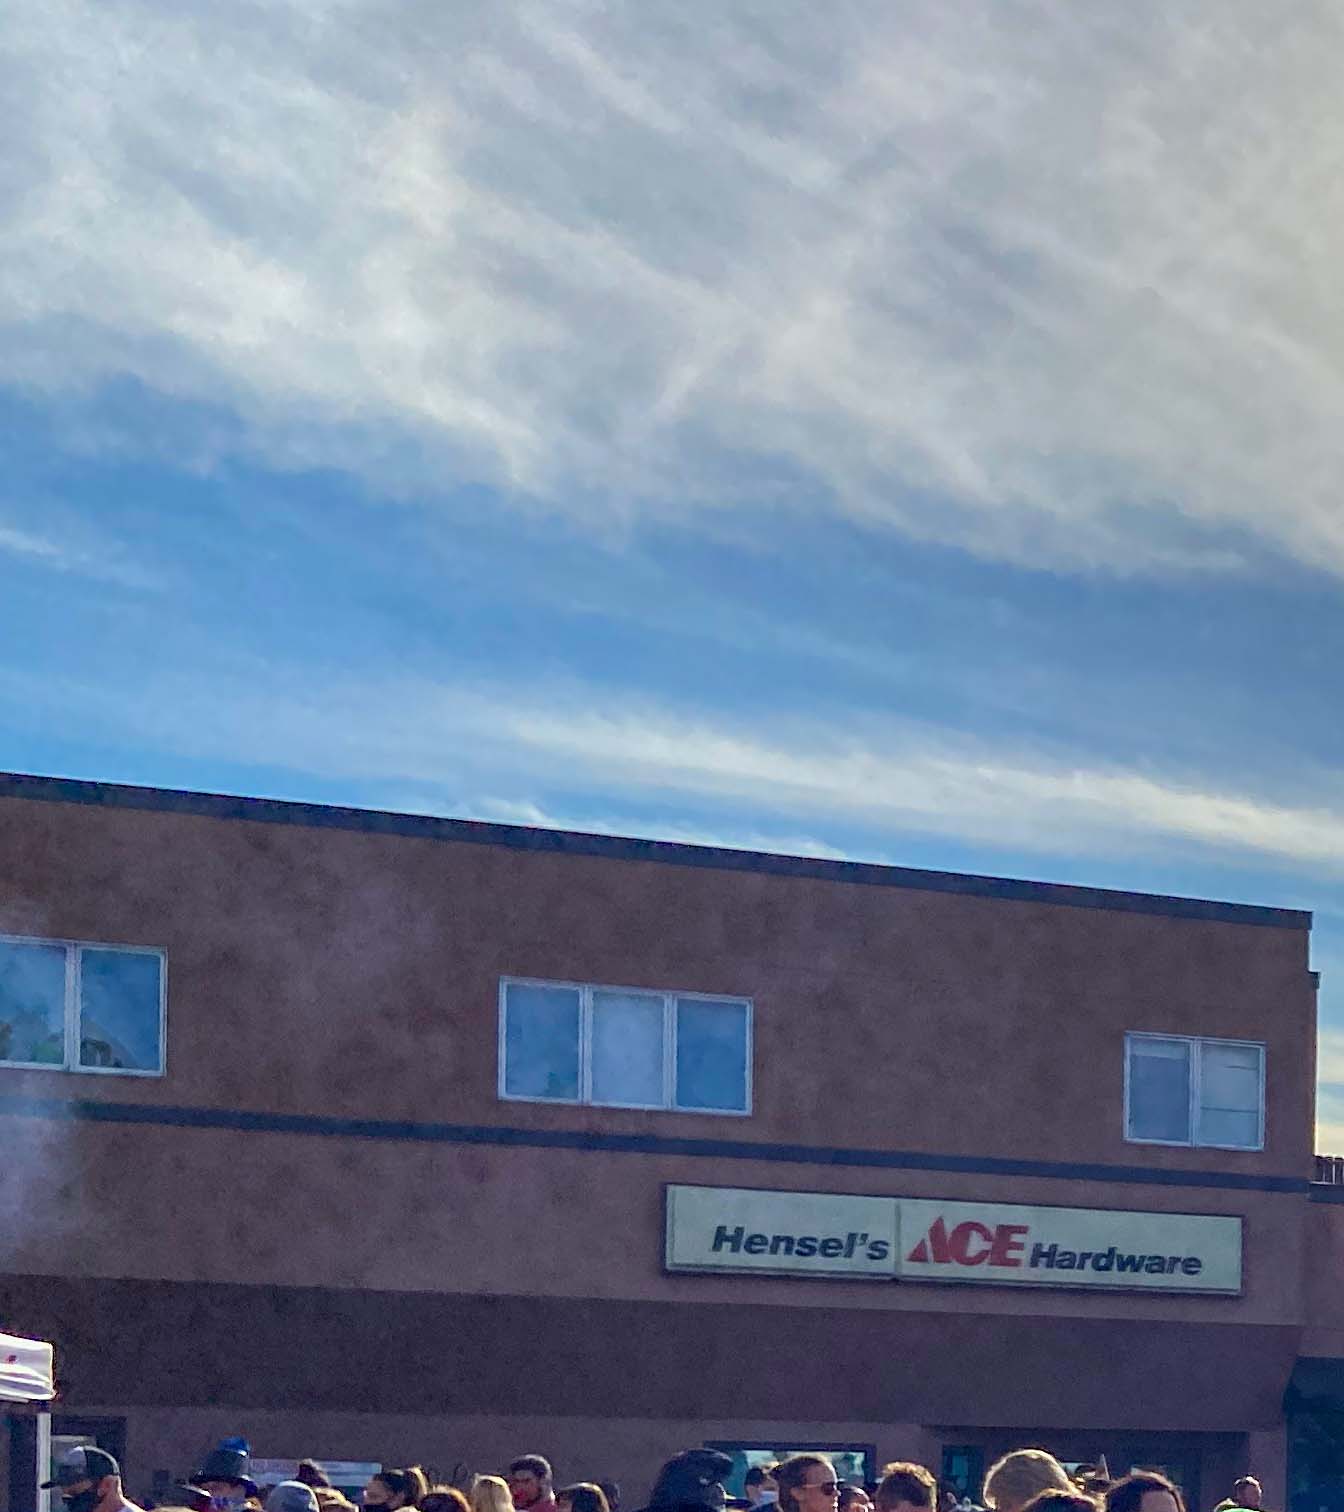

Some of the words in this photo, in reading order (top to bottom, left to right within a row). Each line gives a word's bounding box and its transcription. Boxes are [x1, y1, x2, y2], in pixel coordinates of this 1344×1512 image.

[711, 1225, 890, 1261] Hensel's
[906, 1216, 1029, 1267] ACE
[1029, 1242, 1203, 1276] Hardware
